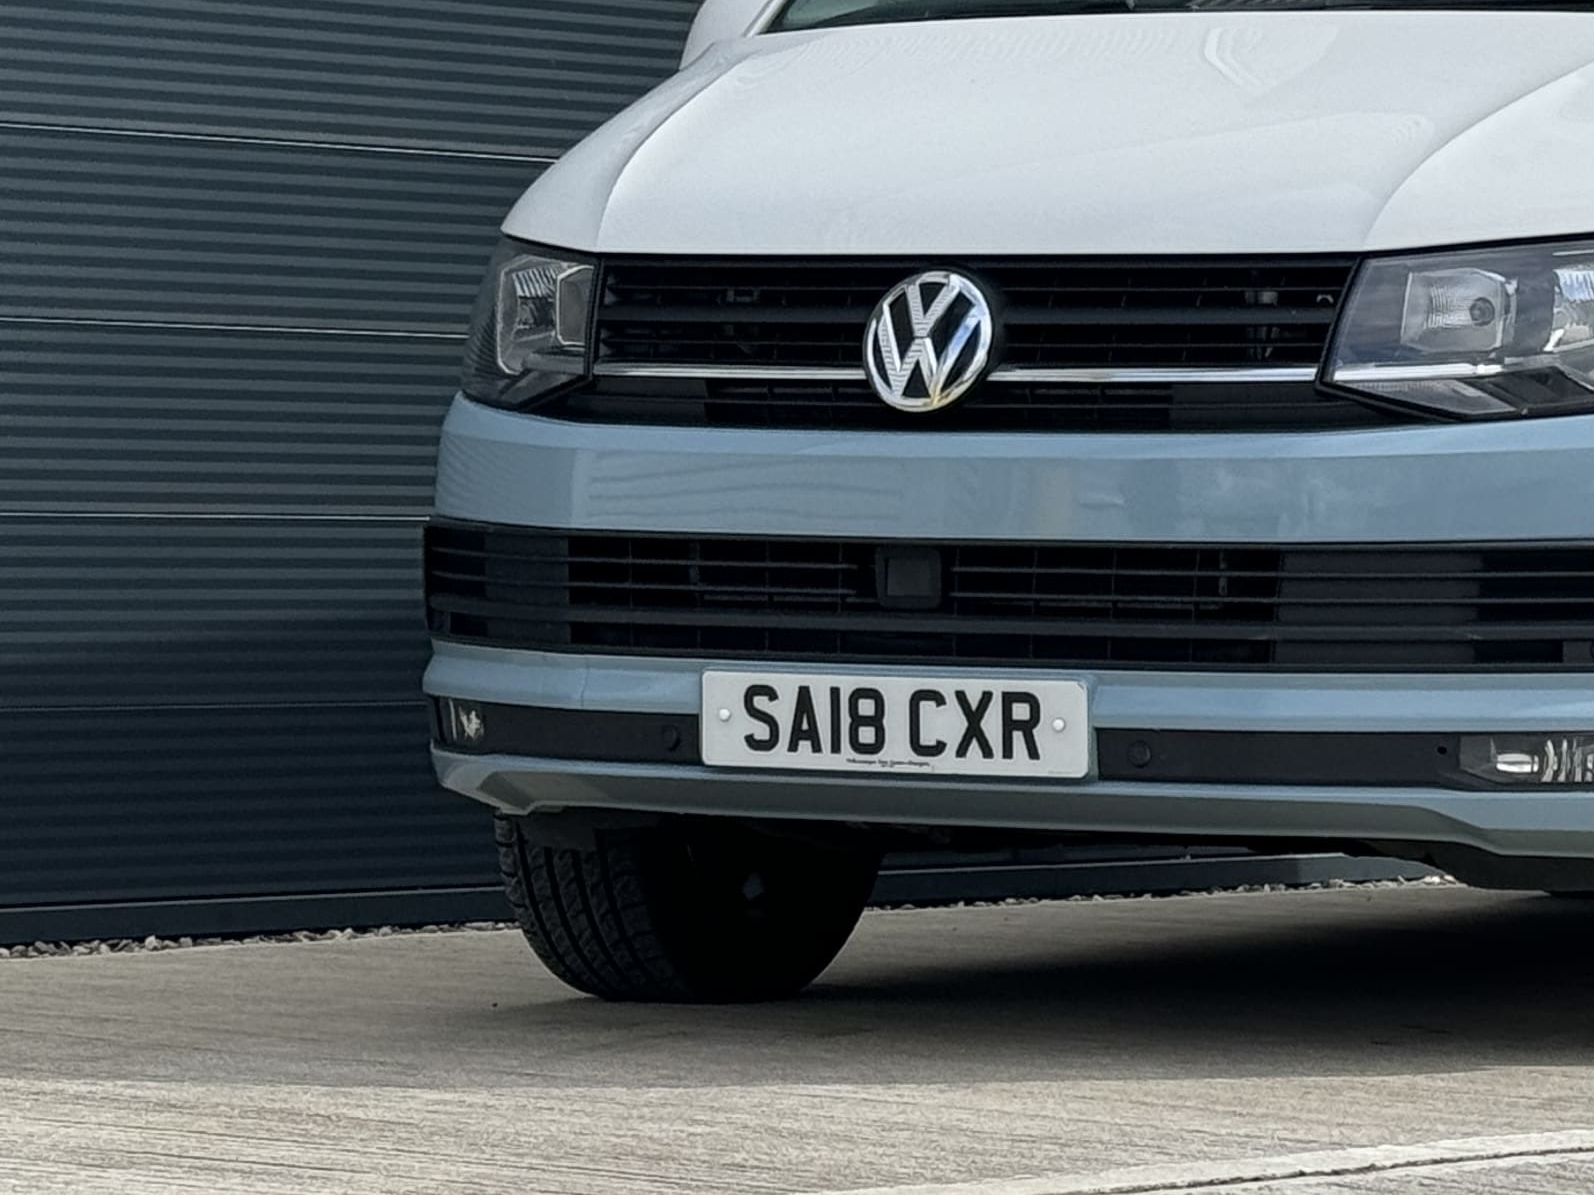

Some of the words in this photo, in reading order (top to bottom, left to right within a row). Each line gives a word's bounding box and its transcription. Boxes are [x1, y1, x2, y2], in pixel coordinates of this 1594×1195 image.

[869, 273, 989, 409] VW
[743, 684, 886, 755] SA18
[908, 688, 1041, 761] CXR
